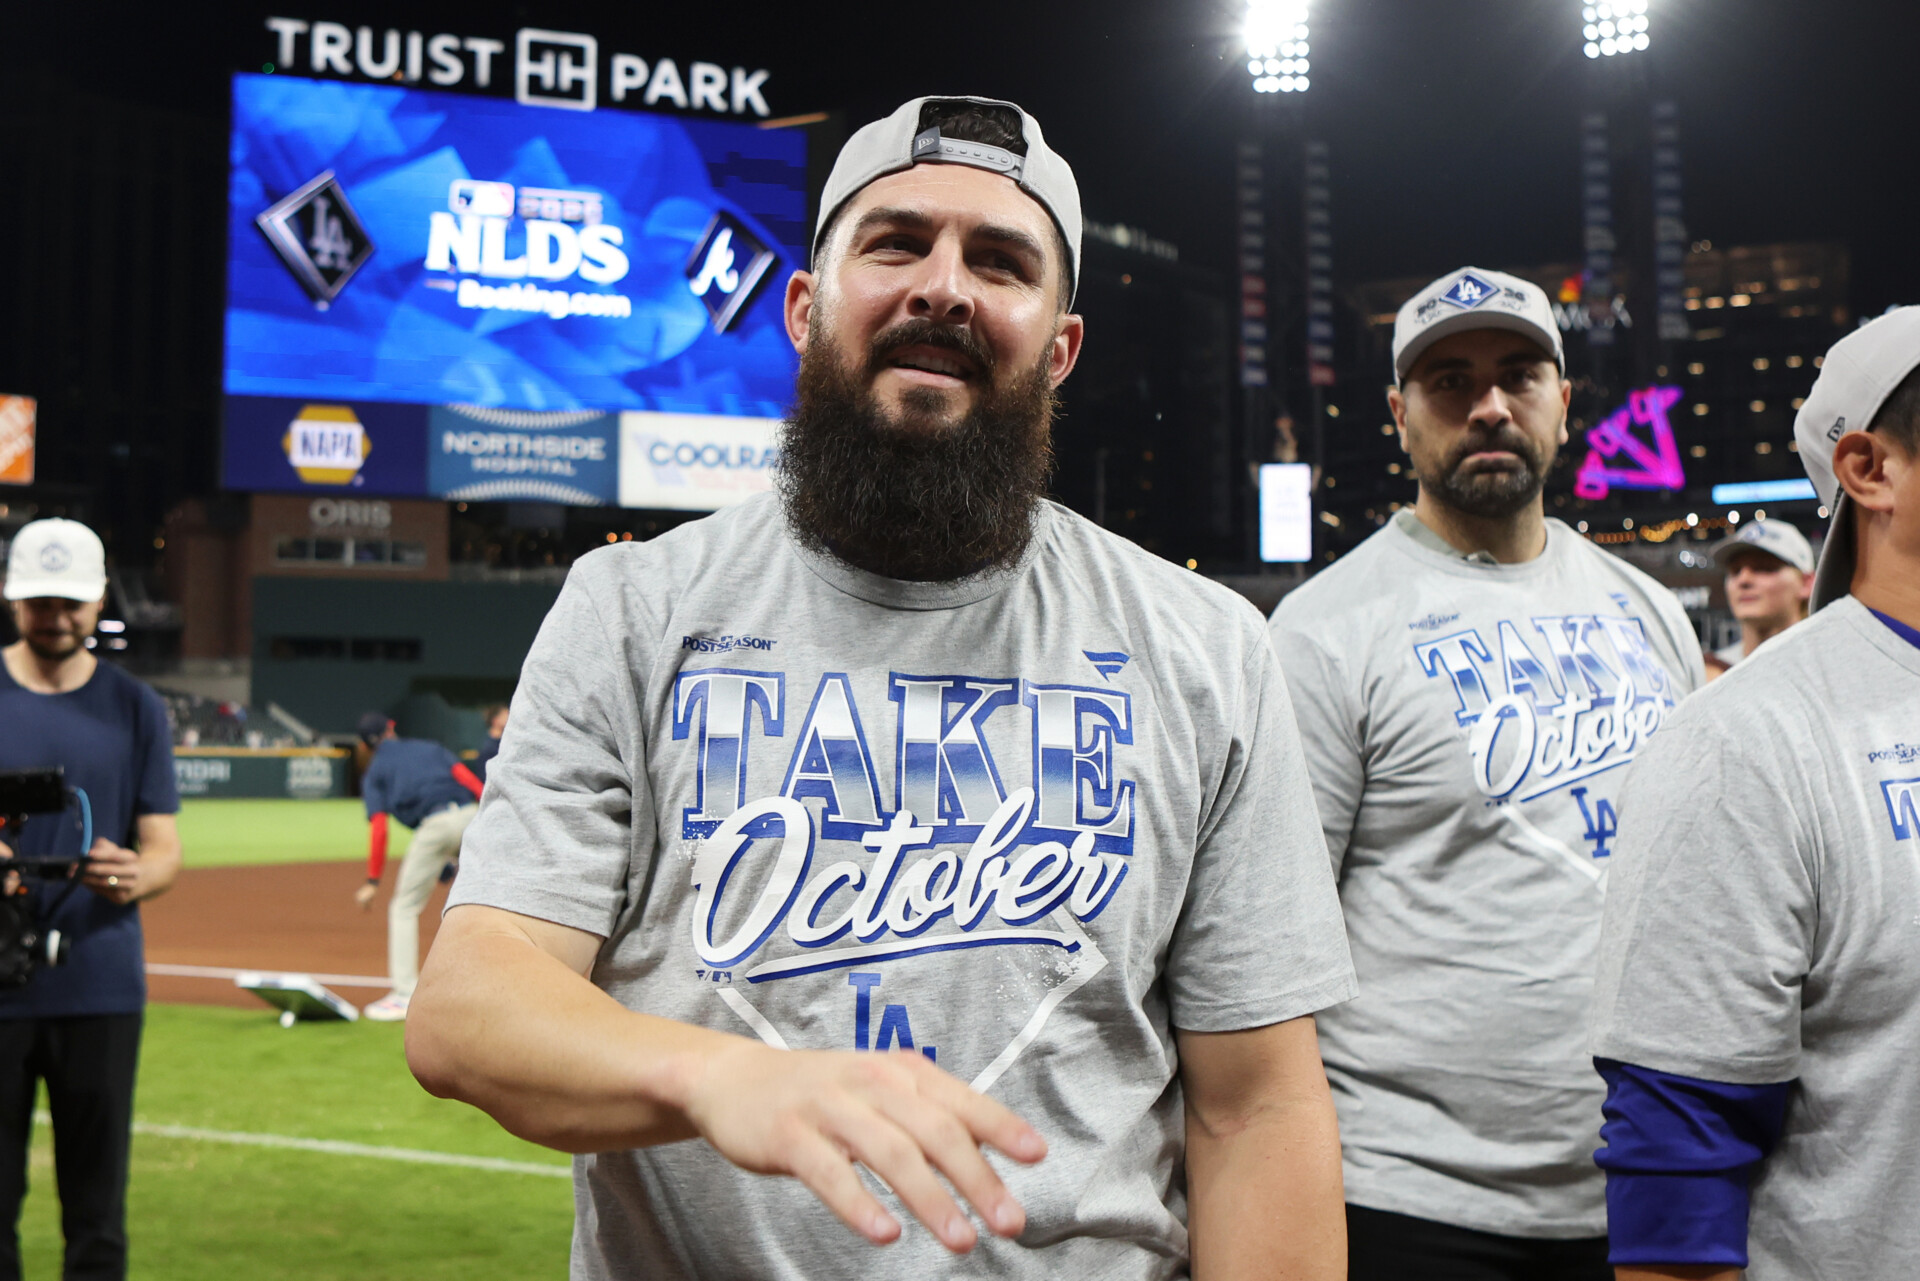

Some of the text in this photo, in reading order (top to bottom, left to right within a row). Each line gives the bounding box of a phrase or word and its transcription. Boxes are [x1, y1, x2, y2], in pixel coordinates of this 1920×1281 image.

[266, 17, 770, 116] TRUIST PARK
[424, 211, 630, 285] NLDS
[1457, 279, 1482, 302] LA
[300, 431, 358, 461] NAPA
[442, 430, 606, 461] NORTHSIDE
[649, 441, 784, 470] COOLRA
[471, 456, 577, 477] HOSPITAL
[682, 635, 772, 653] POSTSEASON
[1413, 615, 1675, 728] TAKE
[672, 667, 1136, 857] TAKE
[691, 786, 1129, 968] October
